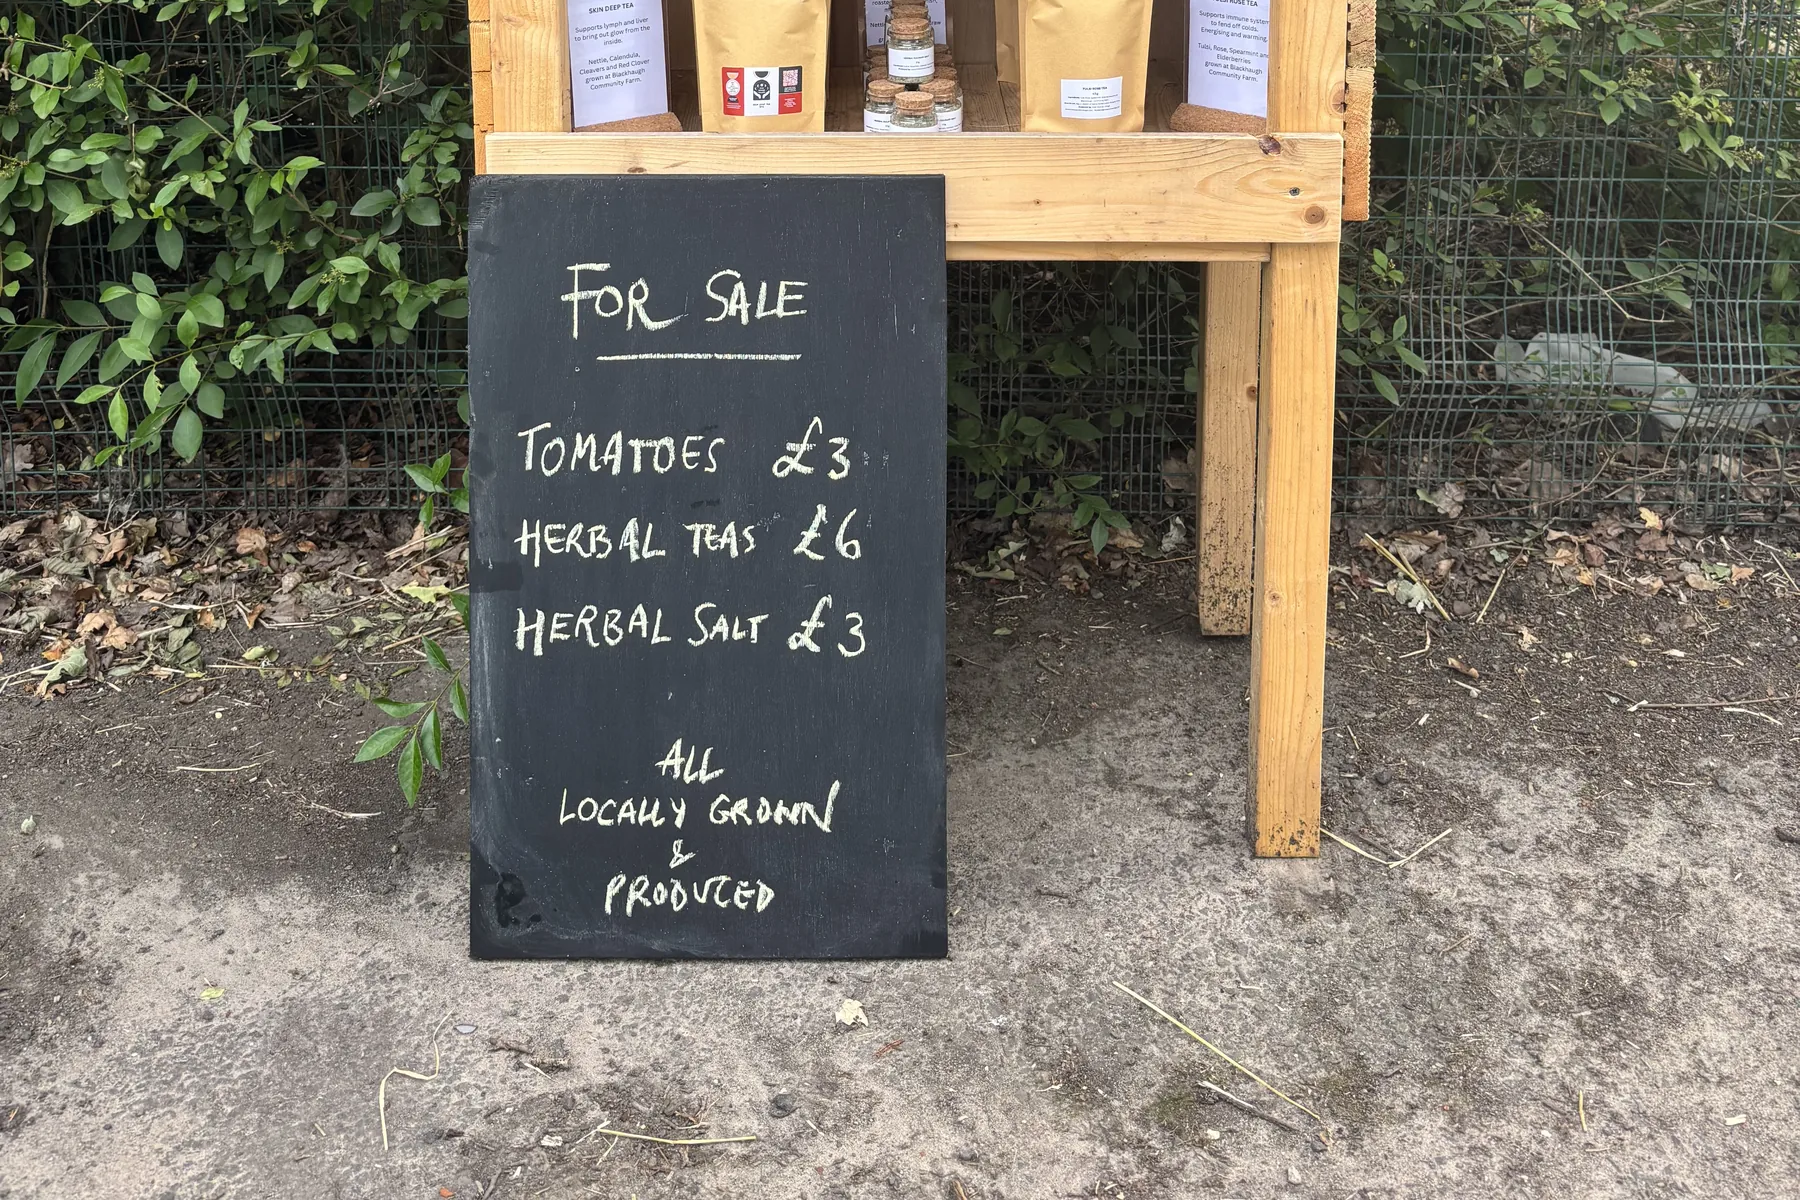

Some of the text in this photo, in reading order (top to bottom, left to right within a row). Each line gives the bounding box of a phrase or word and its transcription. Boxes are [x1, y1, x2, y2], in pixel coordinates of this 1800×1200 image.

[605, 4, 621, 12] DEEP
[1199, 11, 1225, 19] Supports
[1226, 14, 1249, 22] immune
[575, 24, 603, 33] Supports
[604, 21, 622, 30] lymph
[1201, 27, 1230, 37] Energising
[1242, 24, 1258, 32] colds.
[582, 32, 598, 41] bring
[610, 29, 624, 37] glow
[609, 52, 640, 61] Calendula,
[1198, 43, 1212, 51] Tulsi,
[1213, 45, 1228, 53] Rose,
[1229, 48, 1258, 57] Spearmint
[1217, 54, 1251, 63] Elderberries
[580, 66, 605, 75] Cleavers
[631, 59, 650, 67] Clover
[1230, 64, 1262, 74] Blackhaugh
[586, 76, 604, 84] grown
[612, 68, 645, 78] Blackhaugh
[1209, 70, 1258, 82] Community Farm.
[590, 80, 624, 90] Community
[561, 263, 808, 340] FOR SALE
[518, 416, 851, 480] TOMATOES £3
[514, 504, 861, 568] HERBAL TEAS £6
[514, 595, 866, 657] HERBAL SALT £3
[655, 738, 725, 784] ALL
[560, 780, 840, 833] LOCALLY GROWN
[669, 839, 696, 869] &
[605, 874, 775, 917] PRODUCED
